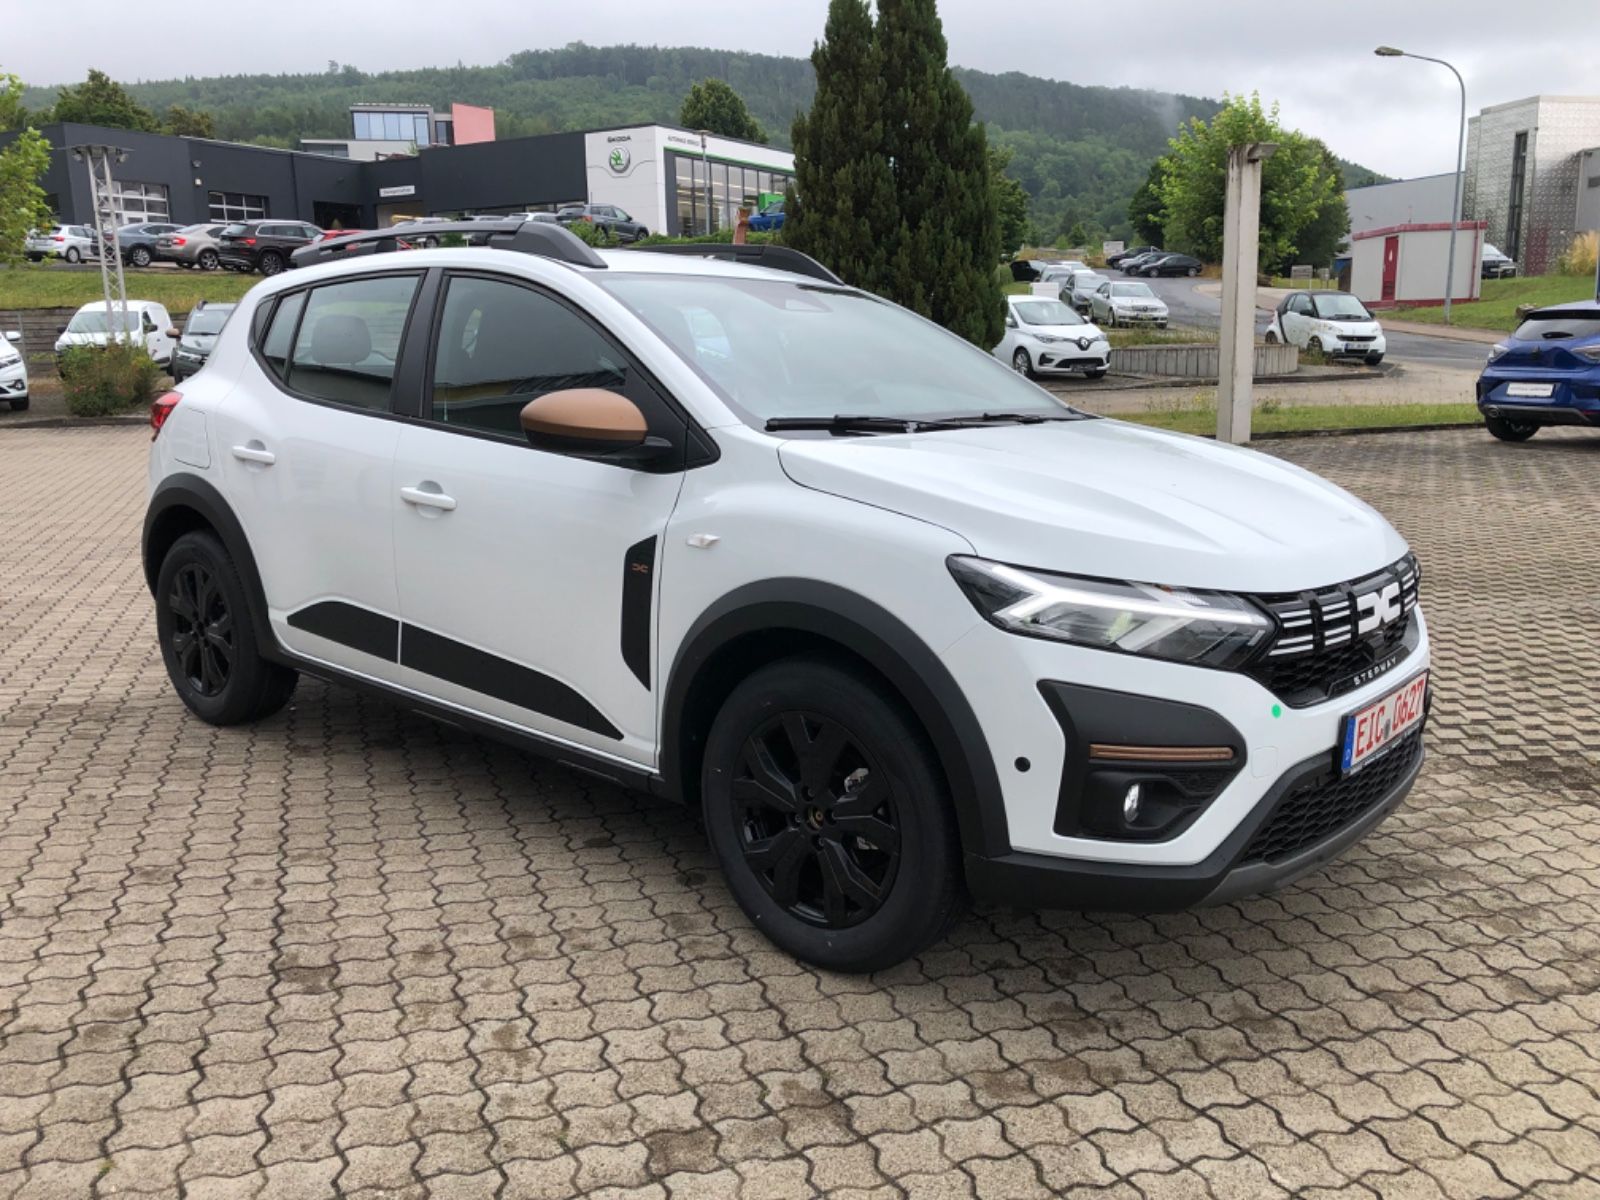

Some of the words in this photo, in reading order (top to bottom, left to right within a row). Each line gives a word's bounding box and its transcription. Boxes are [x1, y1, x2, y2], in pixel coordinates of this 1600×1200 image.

[1353, 655, 1396, 686] STEPWAY
[1356, 705, 1386, 757] EIC
[1392, 679, 1425, 731] 0627
